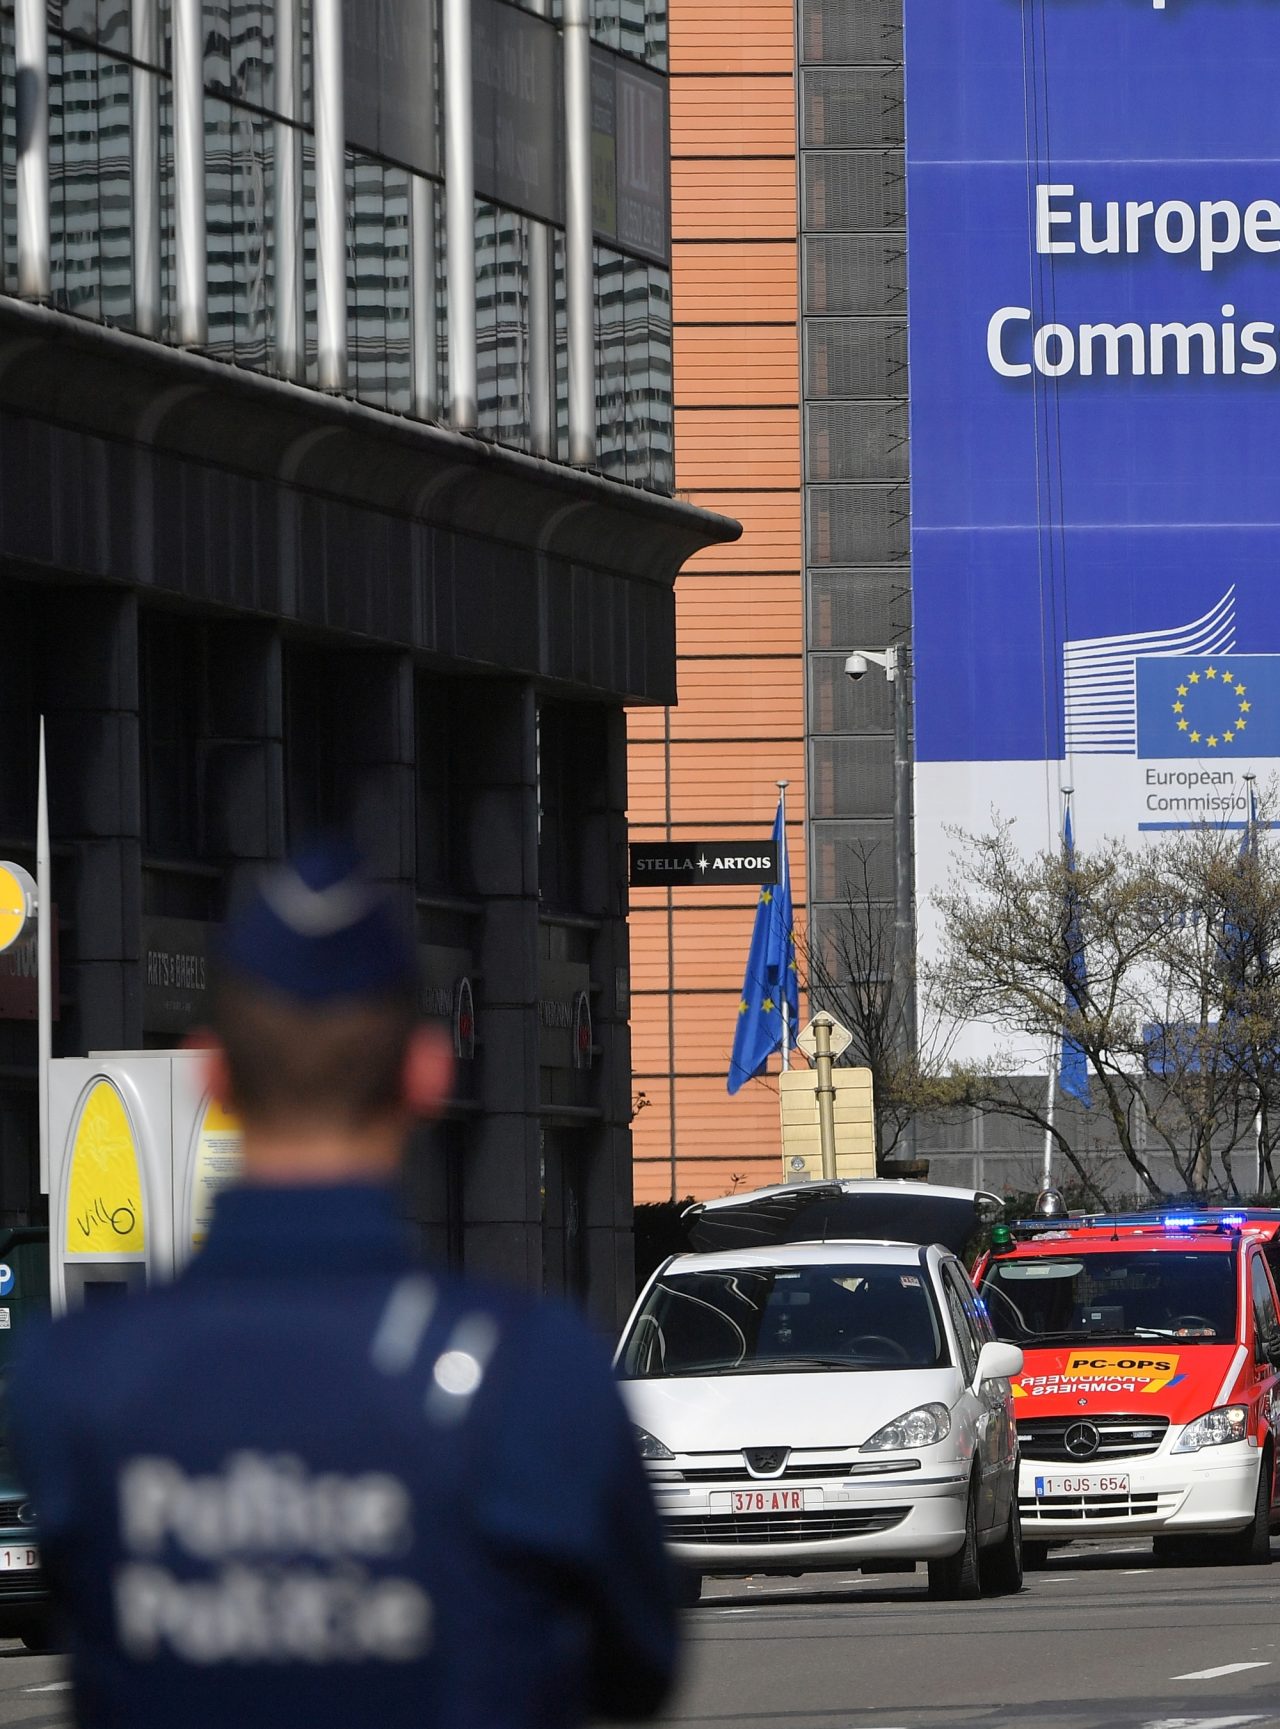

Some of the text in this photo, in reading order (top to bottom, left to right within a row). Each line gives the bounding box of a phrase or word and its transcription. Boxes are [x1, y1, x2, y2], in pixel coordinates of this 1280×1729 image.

[1145, 768, 1234, 789] European
[636, 856, 772, 871] STELLA ARTOIS
[175, 953, 206, 991] BAGELS
[1072, 1359, 1171, 1371] PC-OPS
[735, 1491, 800, 1511] 378-AYR
